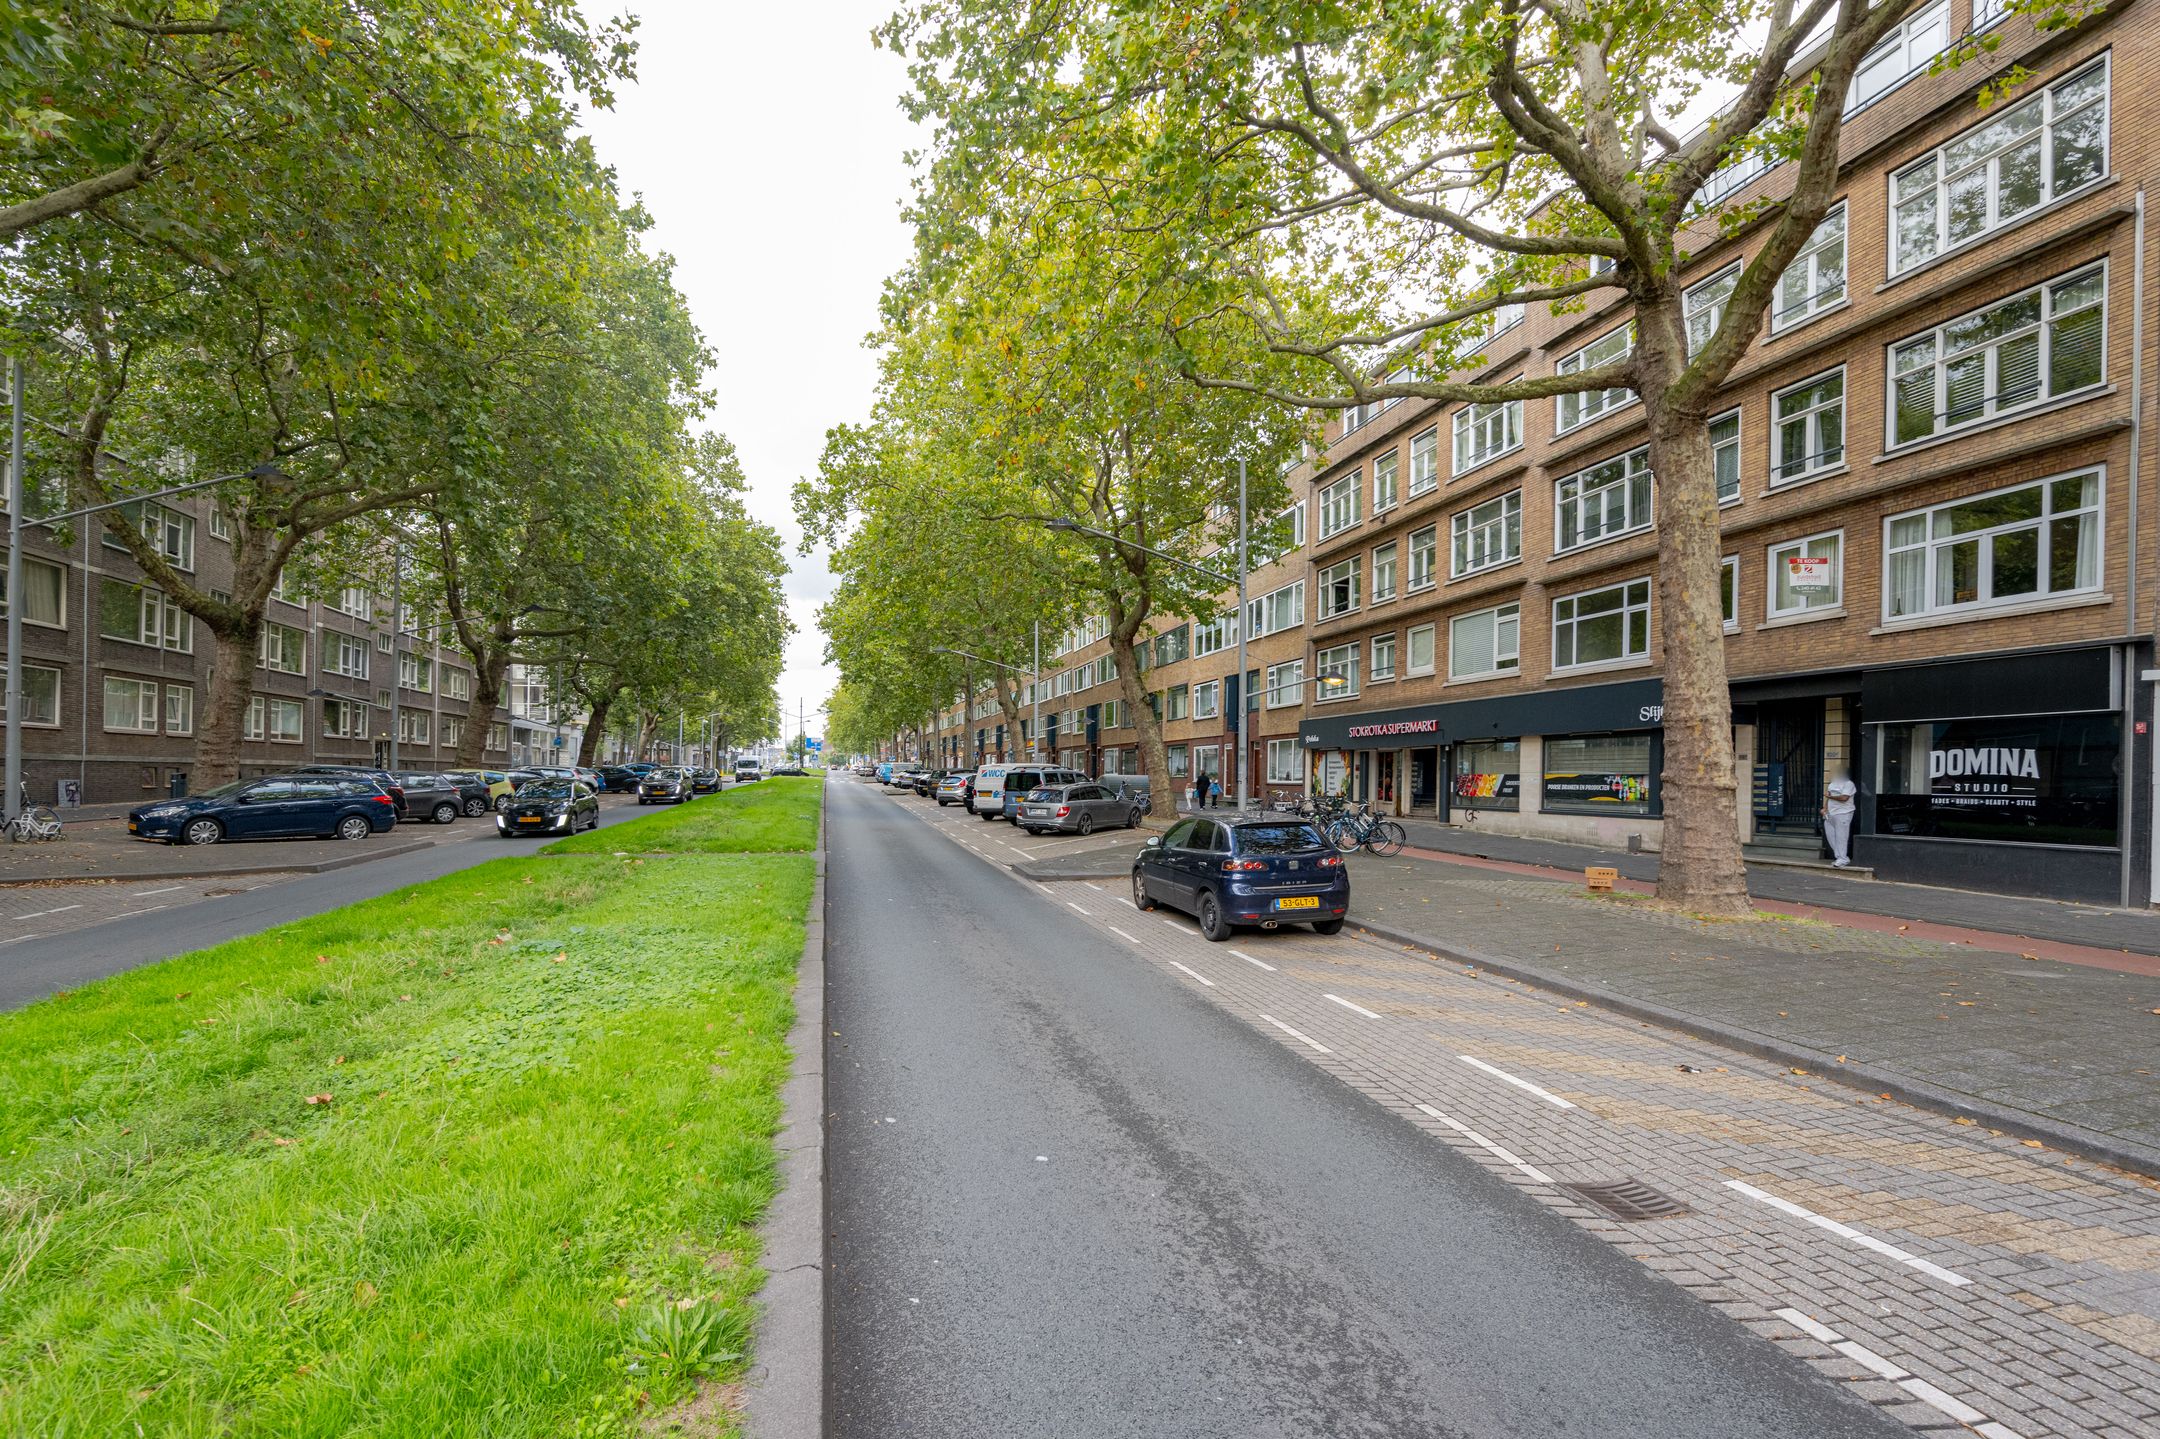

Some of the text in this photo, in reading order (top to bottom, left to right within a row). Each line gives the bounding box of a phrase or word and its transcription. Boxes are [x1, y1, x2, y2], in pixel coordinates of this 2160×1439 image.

[1349, 720, 1438, 738] STOKROTKA SUPERMARKT
[1929, 748, 2041, 779] DOMINA
[988, 769, 1005, 778] WCC
[1954, 783, 2009, 793] STUDIO
[2016, 799, 2037, 807] STYLE
[1283, 898, 1315, 907] 53-GLT-3
